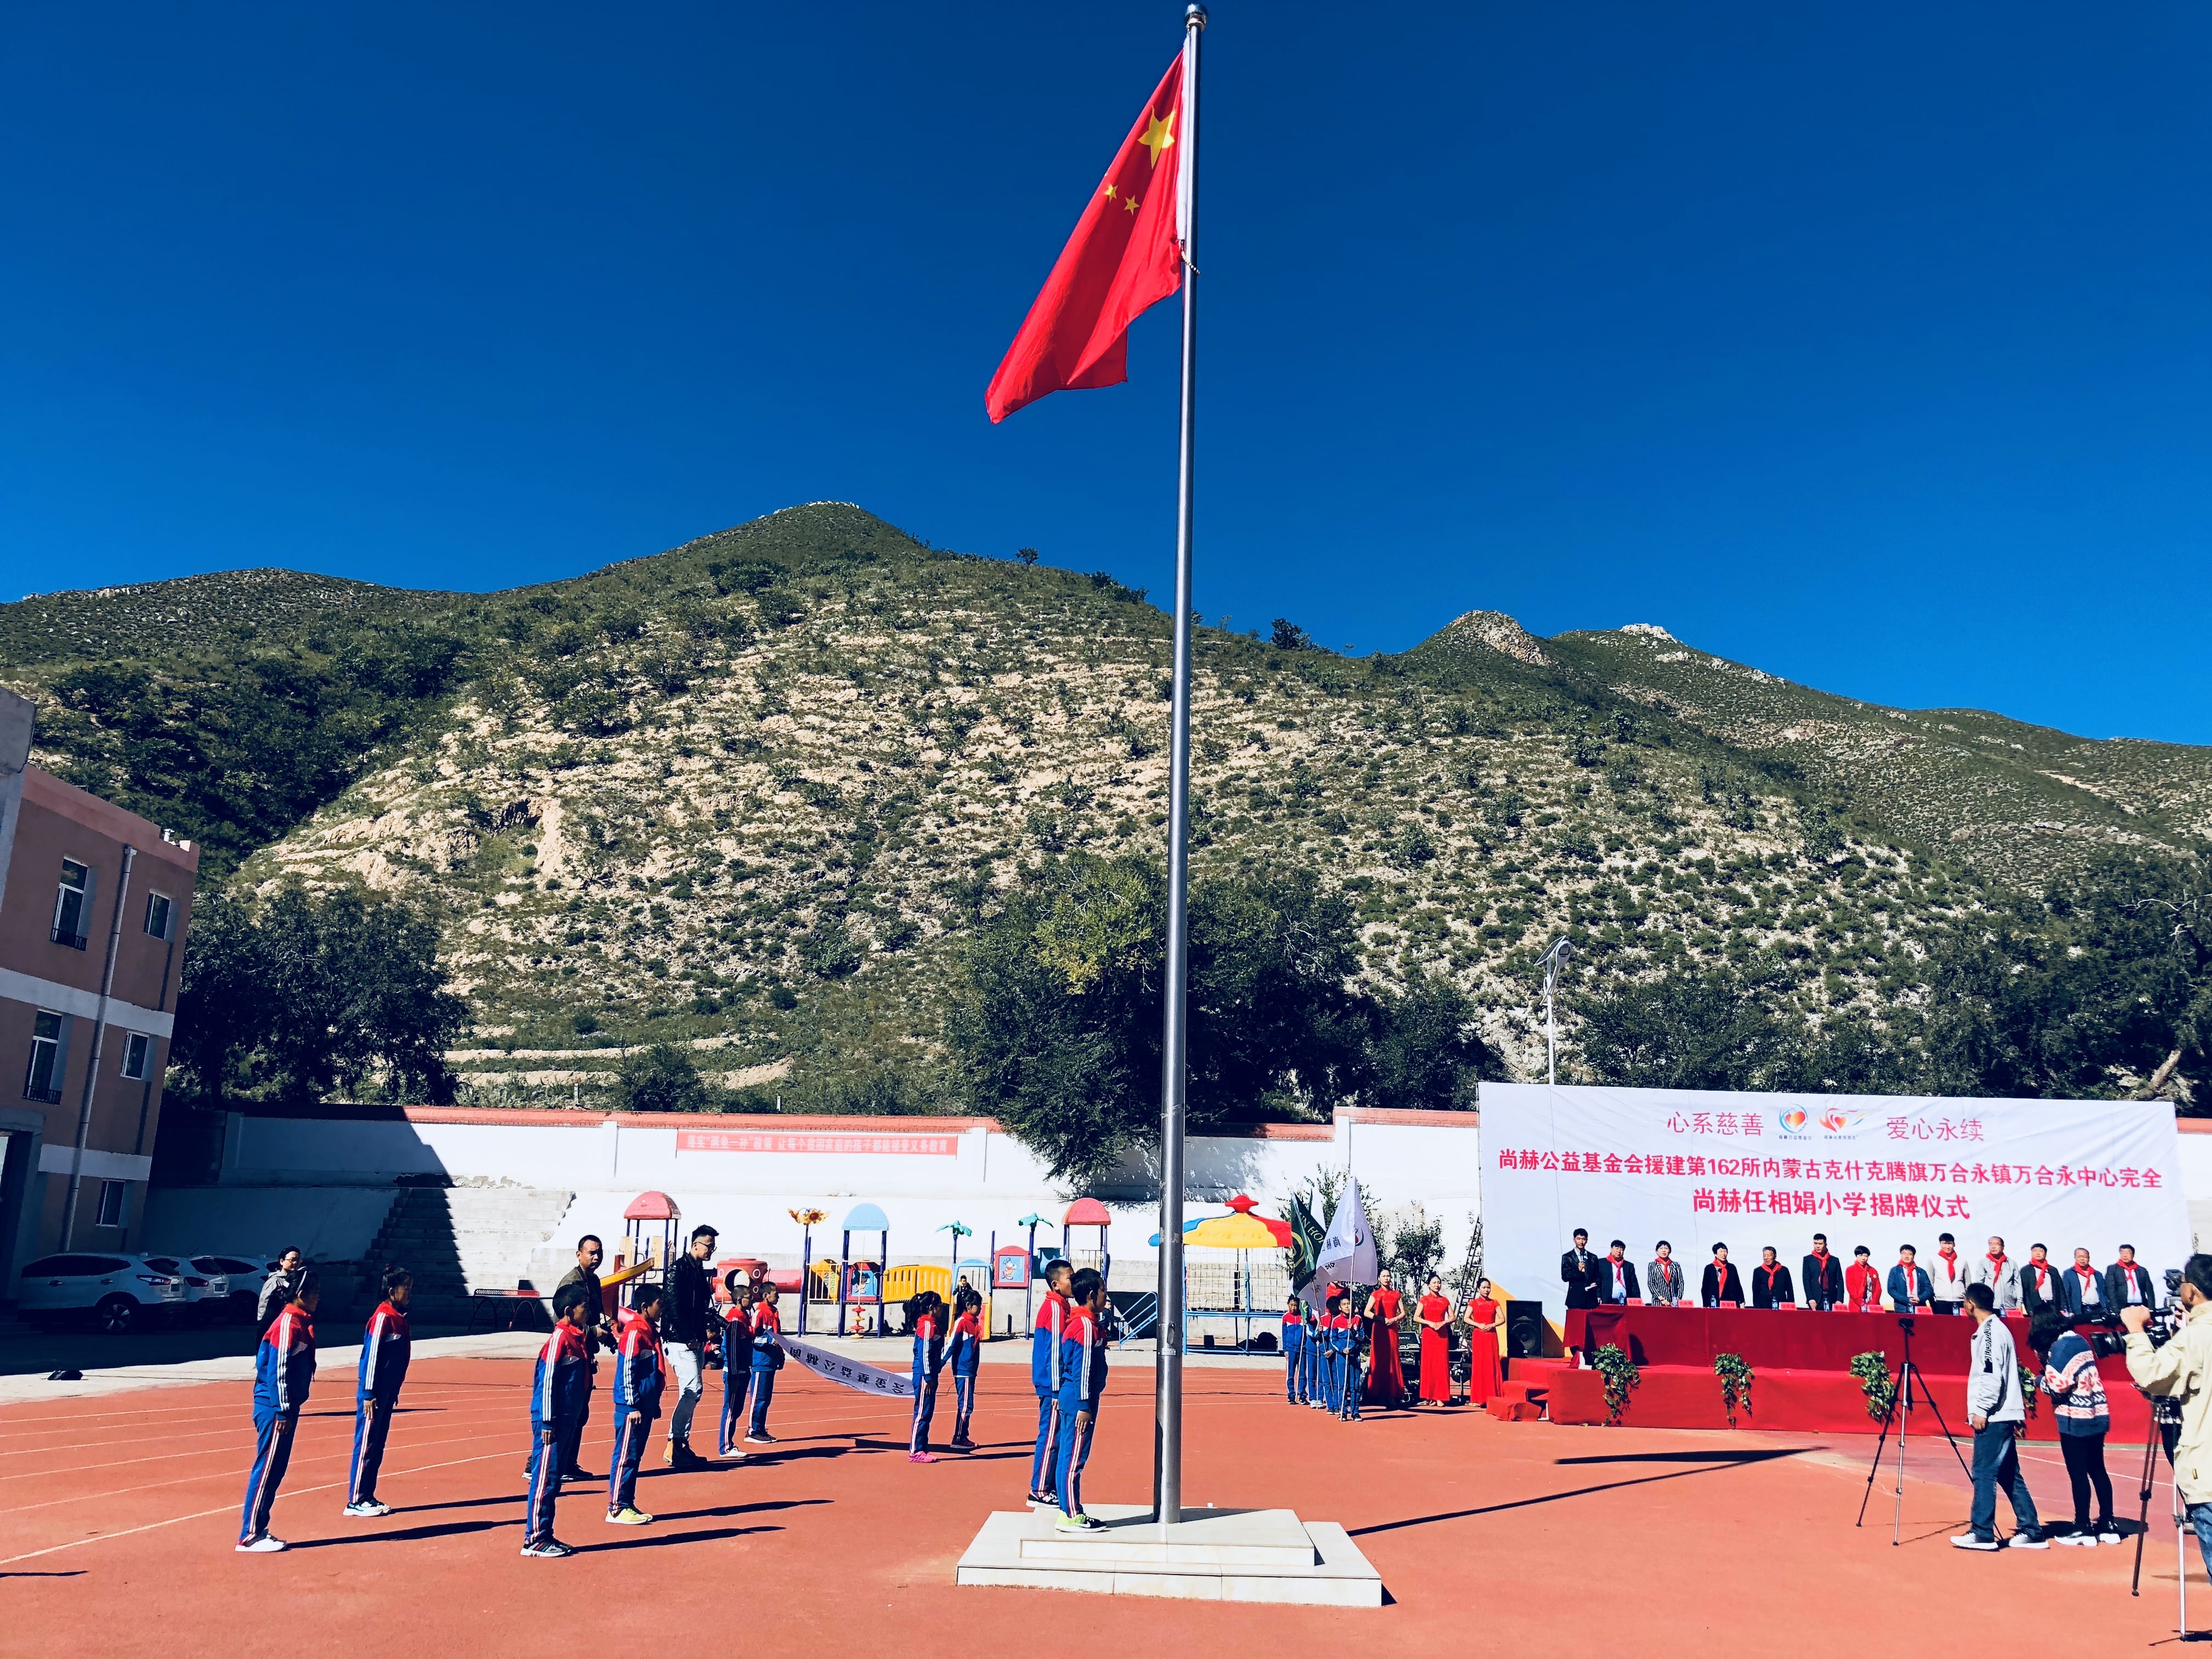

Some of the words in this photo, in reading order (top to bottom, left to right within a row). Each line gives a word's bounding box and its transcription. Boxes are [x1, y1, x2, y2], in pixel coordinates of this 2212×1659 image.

[1666, 1111, 1764, 1137] 心系慈善
[1886, 1116, 1984, 1142] 爱心永续
[1499, 1148, 2163, 1189] 尚赫公益基金会援建第162所内蒙古克什克腾旗万合永镇万合永中心完全
[1694, 1188, 1970, 1220] 尚赫任相娟小学揭牌仪式
